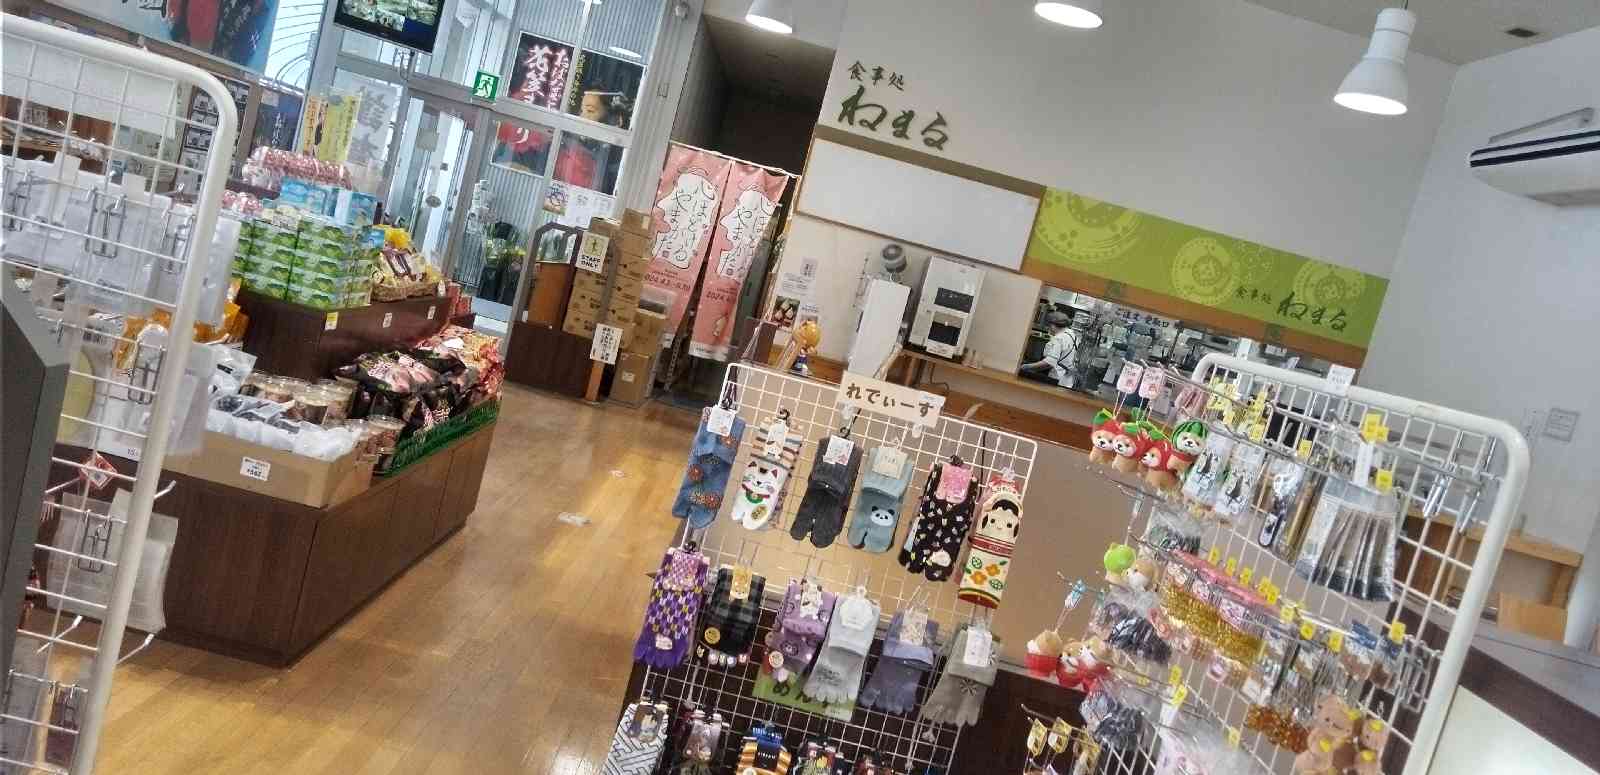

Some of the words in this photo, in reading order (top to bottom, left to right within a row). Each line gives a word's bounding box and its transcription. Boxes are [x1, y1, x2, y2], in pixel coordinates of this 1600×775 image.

[848, 60, 905, 91] 食事処
[838, 85, 949, 150] ねまる
[581, 255, 601, 264] STAFF
[581, 260, 598, 269] ONLY
[1277, 292, 1347, 333] ねまる
[846, 383, 934, 418] れでぃーす
